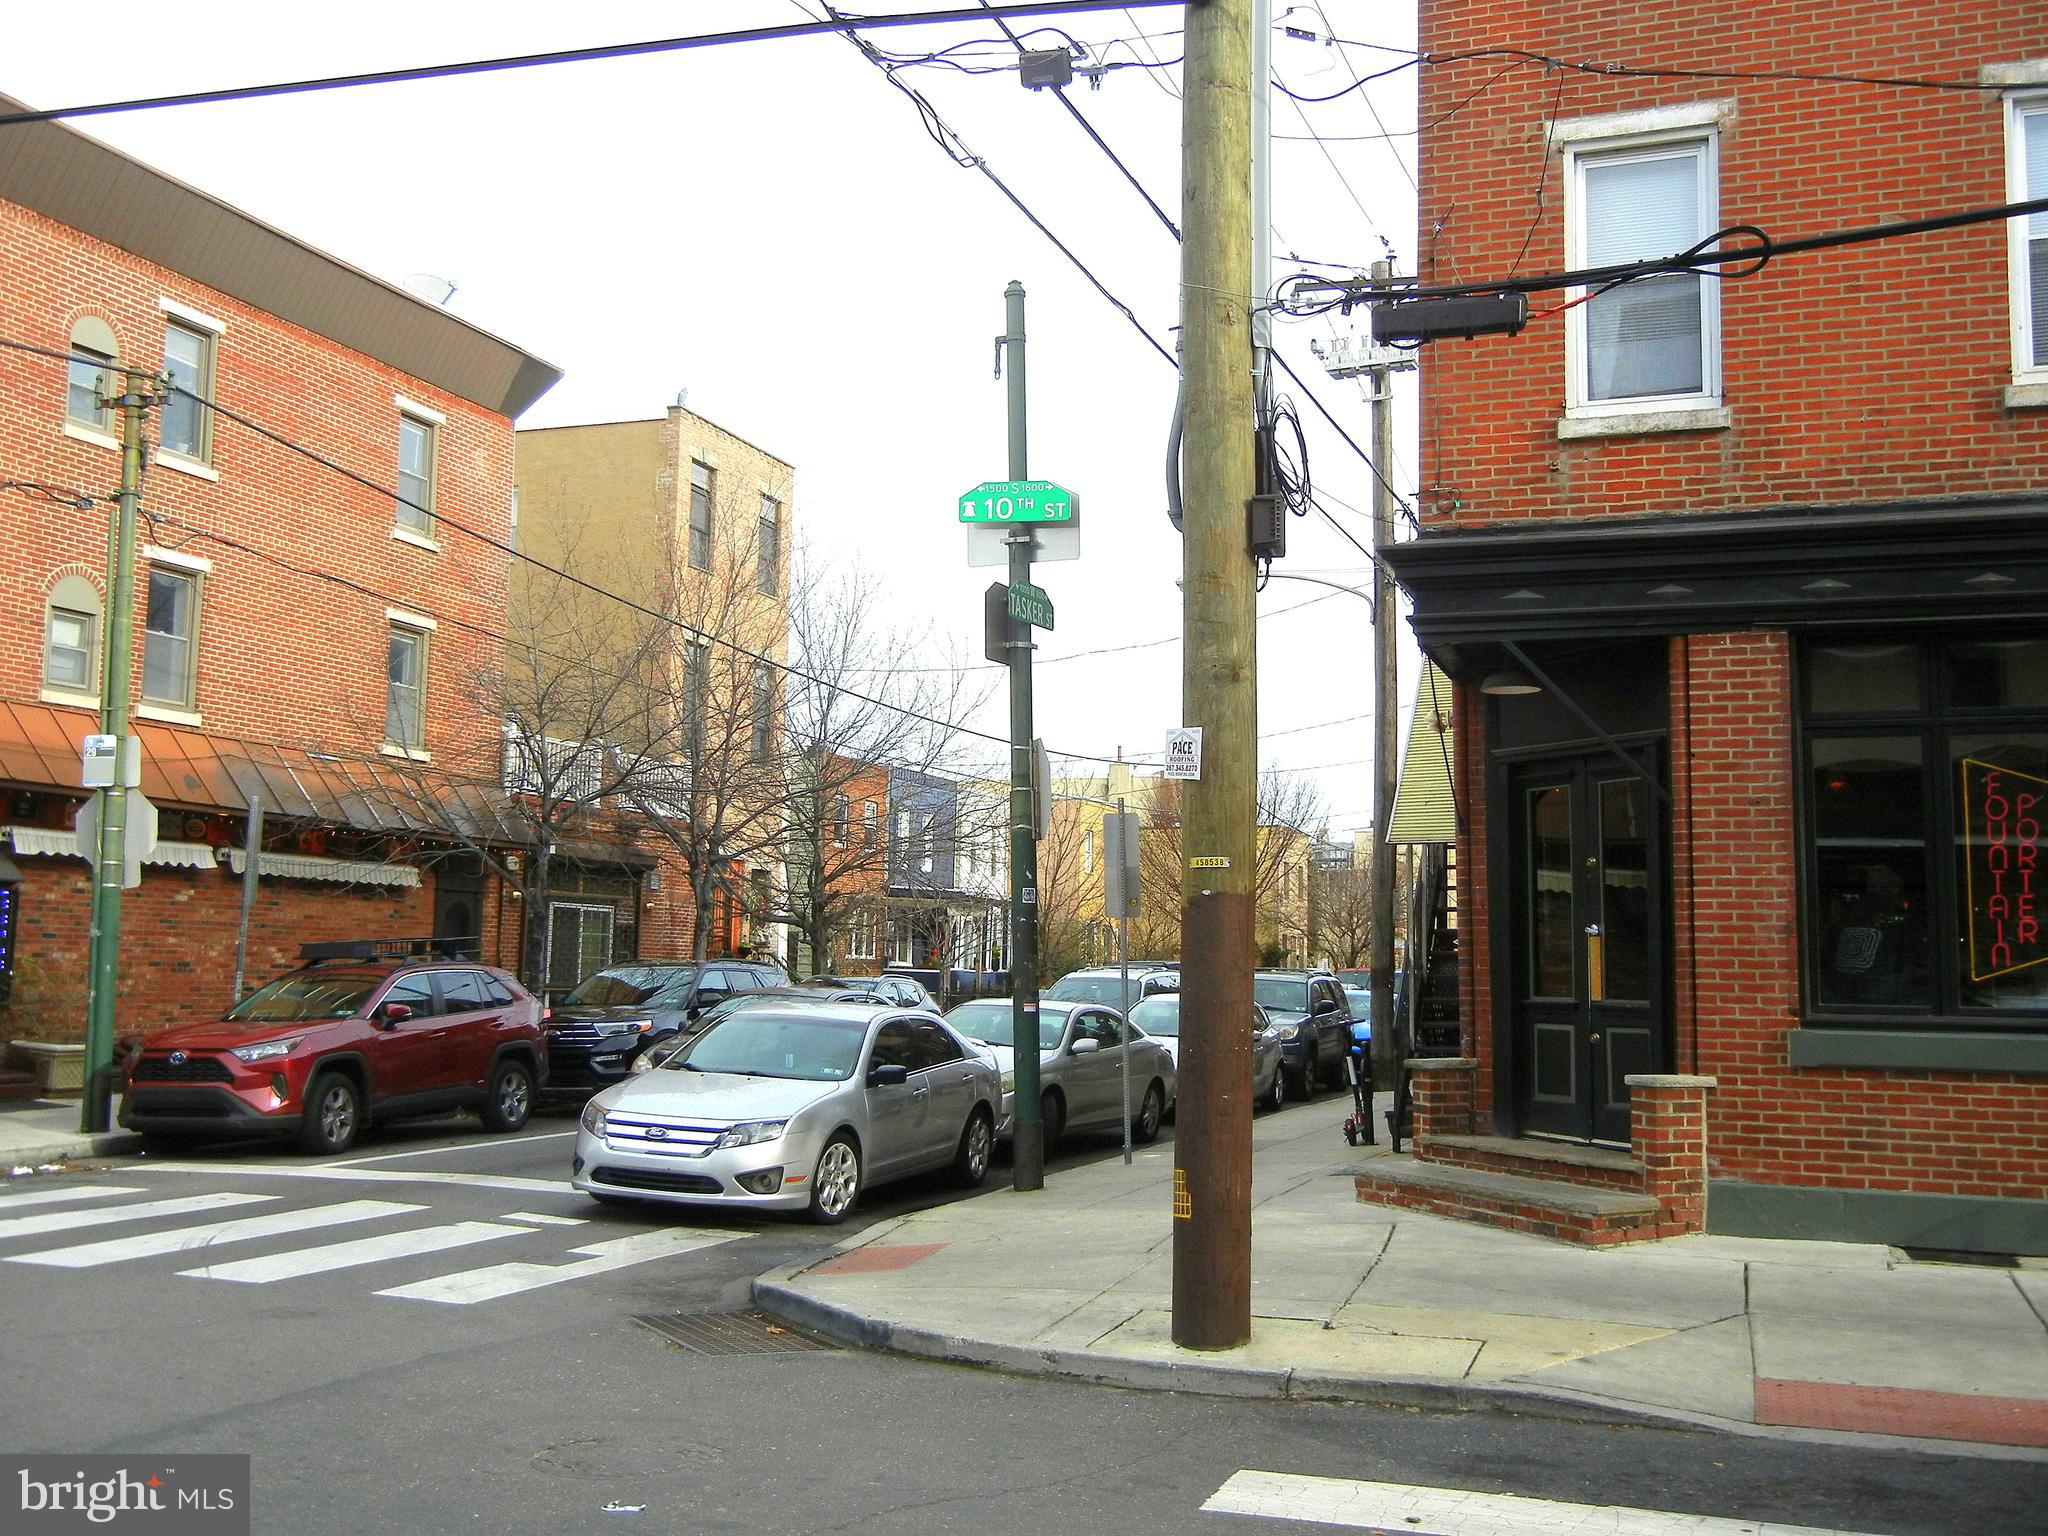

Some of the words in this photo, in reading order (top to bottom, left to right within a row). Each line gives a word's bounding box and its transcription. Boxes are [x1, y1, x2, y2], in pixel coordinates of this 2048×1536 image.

[984, 484, 1009, 493] 1500
[1011, 482, 1020, 494] S
[1022, 483, 1044, 492] 1600
[984, 497, 1034, 520] 10TH
[1044, 503, 1066, 518] ST
[1010, 592, 1044, 625] TASKER
[86, 747, 97, 757] 29
[1172, 741, 1193, 755] PACE
[1984, 771, 2012, 969] FOUNTAIN
[2015, 792, 2041, 945] PORTER
